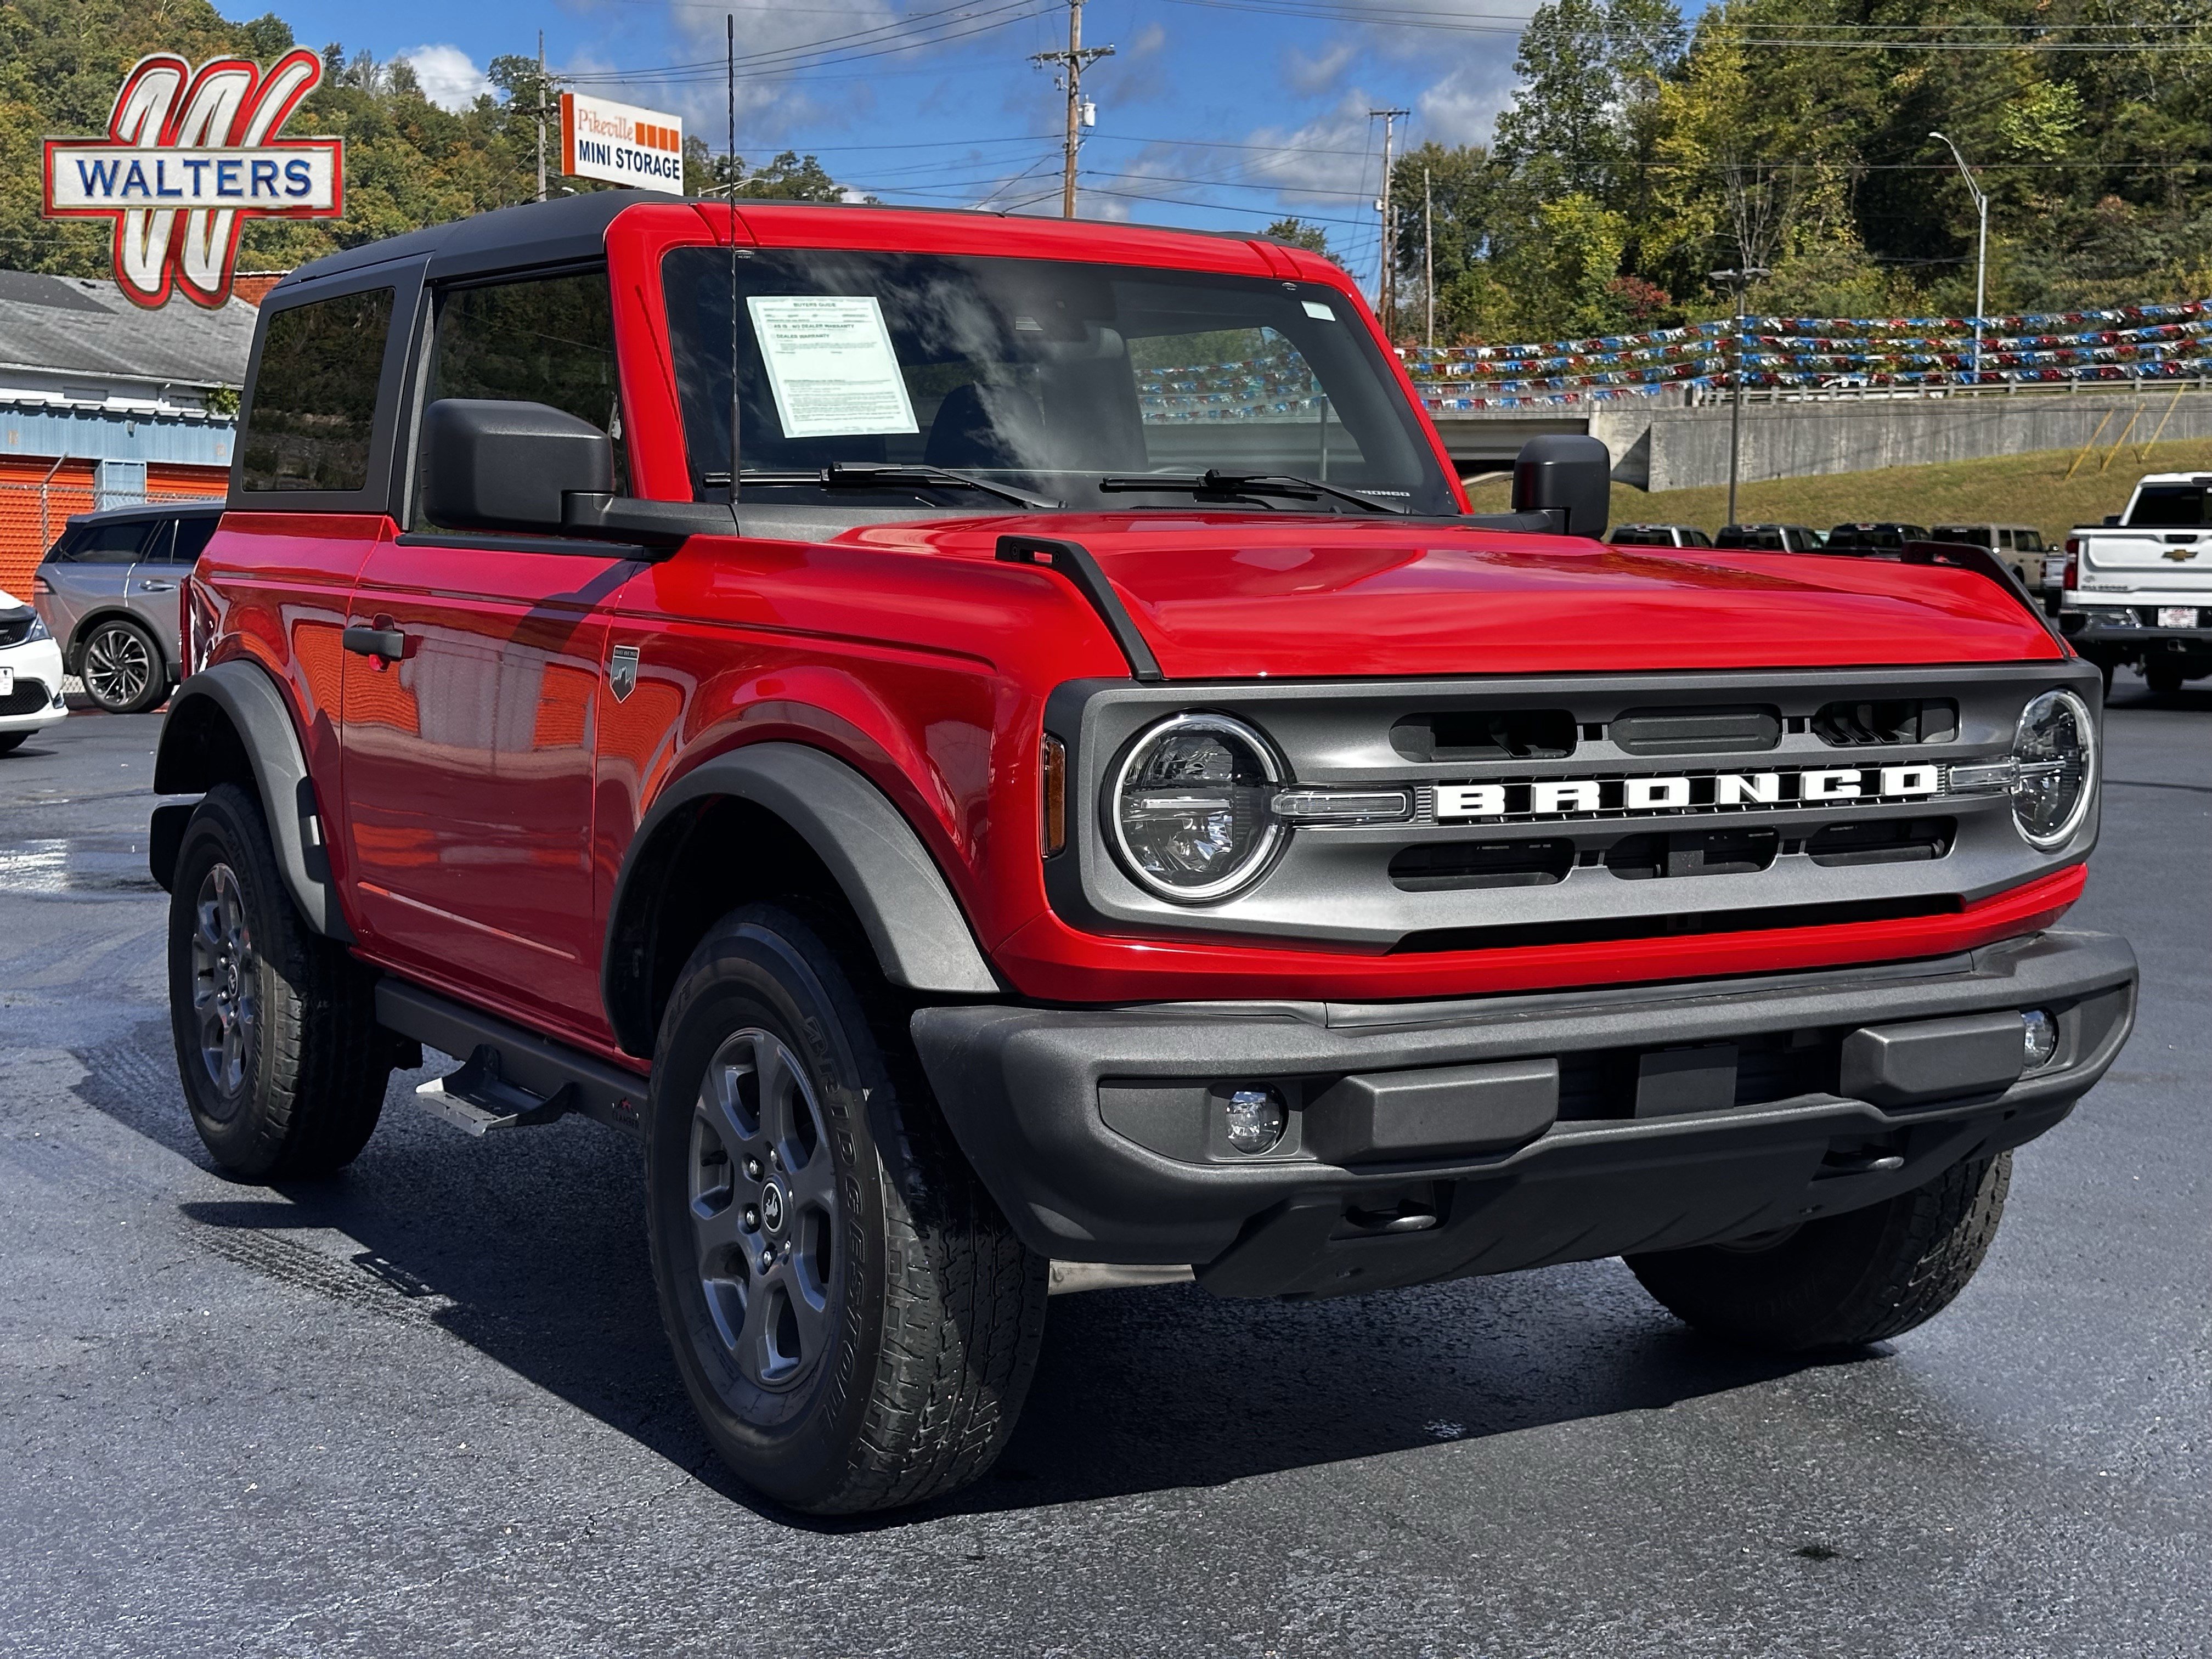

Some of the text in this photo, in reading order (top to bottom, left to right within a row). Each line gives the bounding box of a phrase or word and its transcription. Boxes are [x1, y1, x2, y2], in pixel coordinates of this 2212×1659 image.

[578, 109, 634, 141] Pikeville
[579, 139, 680, 180] MINI STORAGE
[1431, 763, 1939, 817] BRONCO
[799, 1015, 869, 1433] BRIDGESTONE
